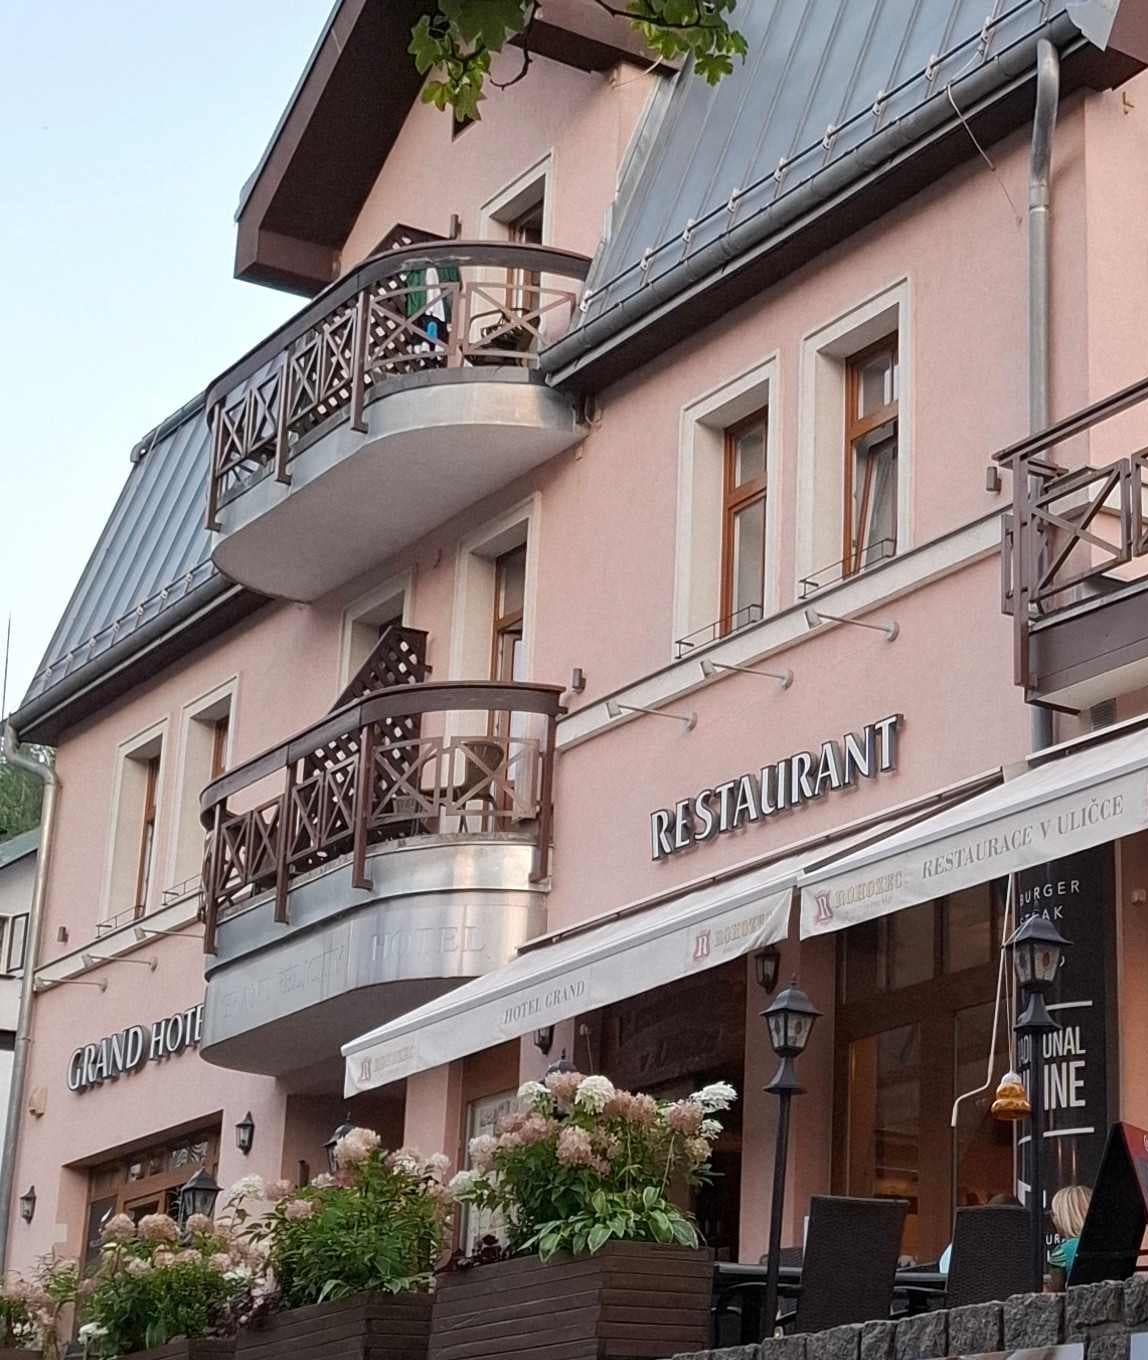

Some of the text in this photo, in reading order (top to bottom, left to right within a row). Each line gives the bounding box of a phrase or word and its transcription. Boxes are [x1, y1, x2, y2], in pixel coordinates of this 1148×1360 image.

[650, 713, 903, 861] RESTAURANT
[921, 794, 1124, 880] RESTAURACE V ULIČCE
[1020, 880, 1080, 907] BURGER
[504, 981, 585, 1025] HOTEL GRAND
[67, 1003, 205, 1092] GRAND HOTE
